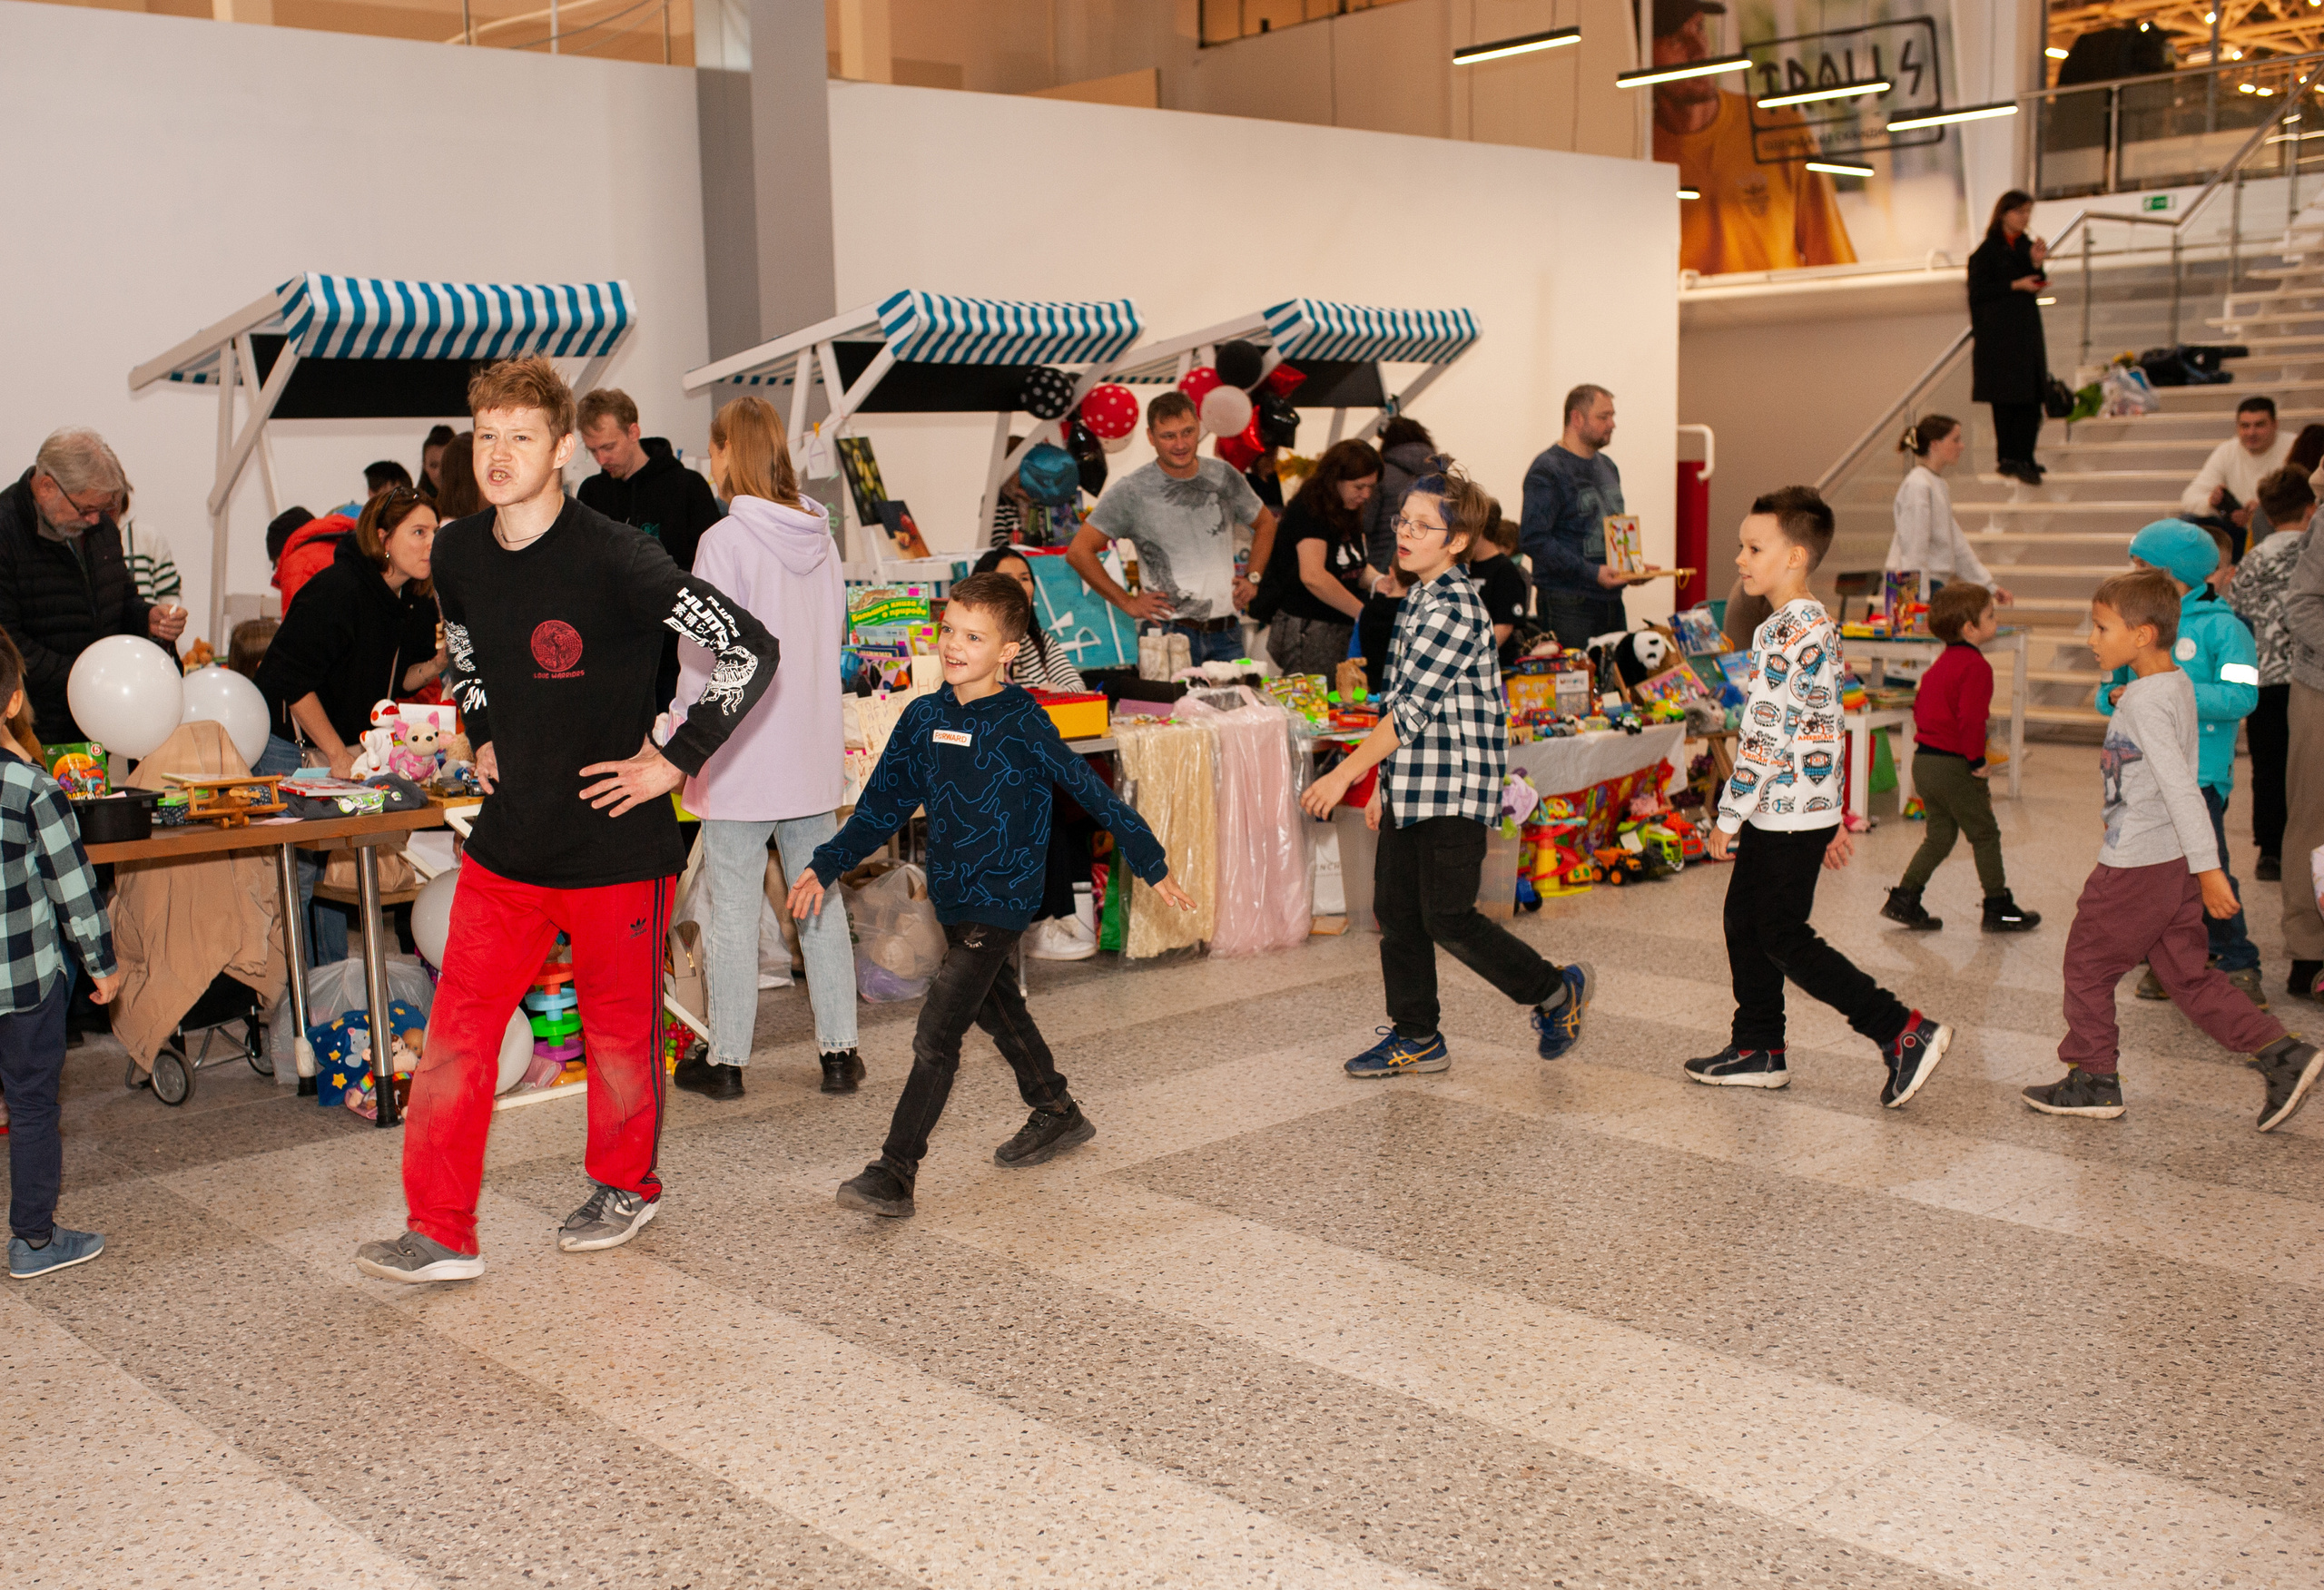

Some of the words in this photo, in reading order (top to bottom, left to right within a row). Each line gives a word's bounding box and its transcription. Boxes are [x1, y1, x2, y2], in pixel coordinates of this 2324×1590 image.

[852, 604, 890, 623] Большая
[890, 600, 917, 609] книга
[881, 611, 889, 619] о
[889, 606, 927, 617] природе
[551, 670, 586, 680] WARRIORS
[934, 731, 969, 743] FORWARD
